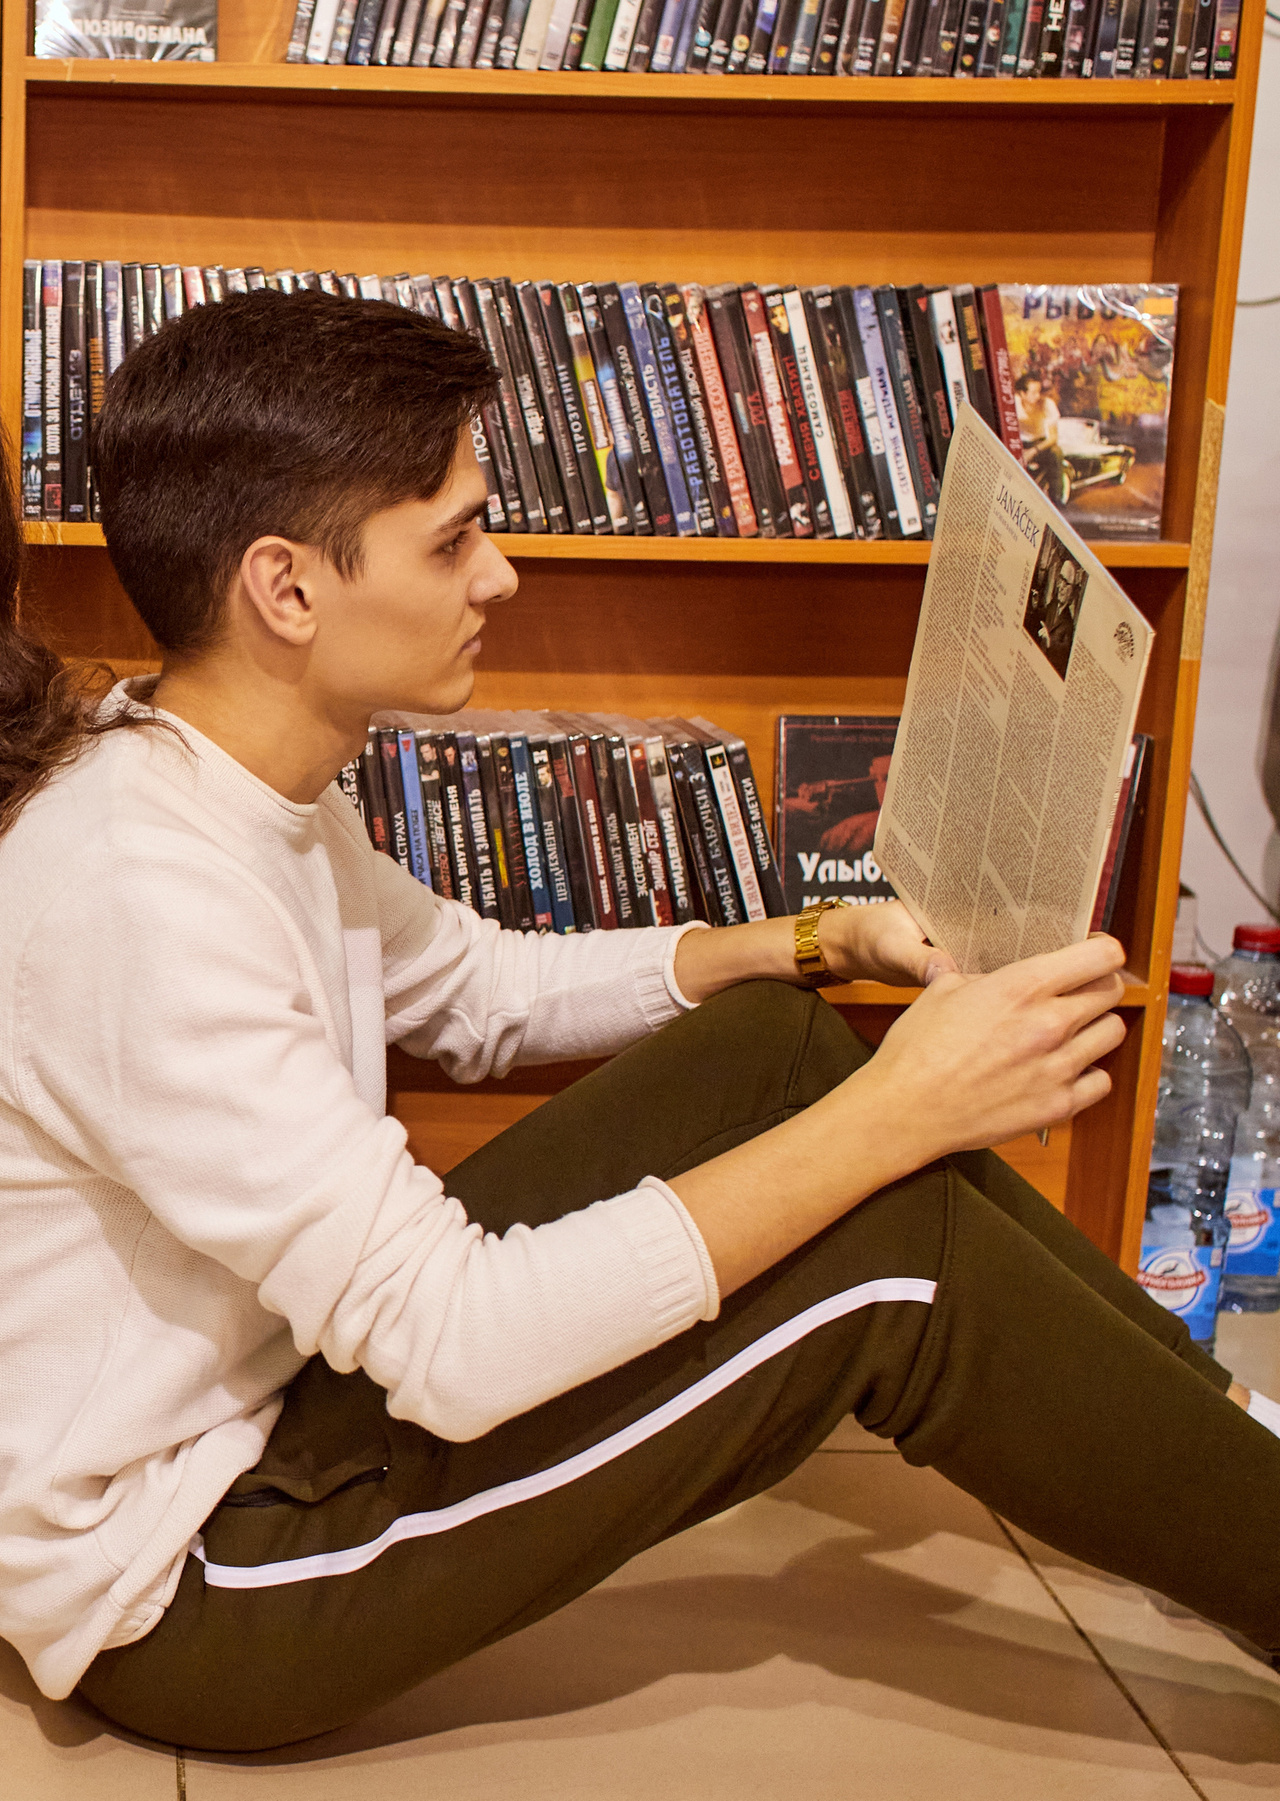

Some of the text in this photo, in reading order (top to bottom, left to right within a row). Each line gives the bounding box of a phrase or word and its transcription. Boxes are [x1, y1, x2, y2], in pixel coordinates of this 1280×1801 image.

[134, 23, 208, 46] ОБМАНА
[24, 328, 41, 417] ОТМОРОЖЕННЫЕ
[45, 357, 60, 407] КРАСНЫМ
[615, 344, 635, 374] ДЕЛО
[679, 347, 702, 396] ДВОРЕЦ
[69, 374, 84, 440] ОТДЕЛ
[640, 364, 666, 418] ВЛАСТЬ
[654, 336, 704, 484] РАБОТОДАТЕЛЬ
[780, 354, 808, 417] ХВАТИТ!
[795, 345, 825, 437] САМОЗВАНЕЦ
[45, 408, 60, 422] ЗА
[45, 424, 60, 454] ОХОТА
[712, 406, 742, 478] РАЗУМНОЕ
[797, 421, 819, 465] МЕНЯ
[996, 484, 1039, 549] JANÁČEK
[430, 799, 446, 844] ВЕГАСЕ
[446, 784, 461, 822] МЕНЯ
[721, 795, 743, 837] ВИДЕЛА
[740, 776, 773, 870] ЧЕРНЫЕ МЕТКИ
[392, 810, 409, 855] СТРАХА
[413, 838, 422, 850] НА
[451, 823, 469, 875] ВНУТРИ
[466, 788, 497, 906] УБИТЬ И ЗАКОПАТЬ
[513, 771, 546, 889] ХОЛОД В ИЮЛЕ
[640, 819, 667, 890] ЭМПАЙР СТЭЙТ
[687, 771, 739, 924] ЭФФЕКТ БАБОЧКИ 3
[415, 852, 426, 876] ЧАСА
[437, 853, 452, 898] ИЙСТВО
[541, 819, 569, 901] ЦЕНА ИЗМЕНЫ
[624, 822, 649, 897] ЭКСПЕРИМЕНТ
[659, 807, 690, 908] ЭПИДЕМИЯ
[735, 848, 752, 870] ЧТО
[797, 851, 888, 884] Улыб
[618, 897, 633, 918] ЧТО
[747, 908, 764, 918] Я
